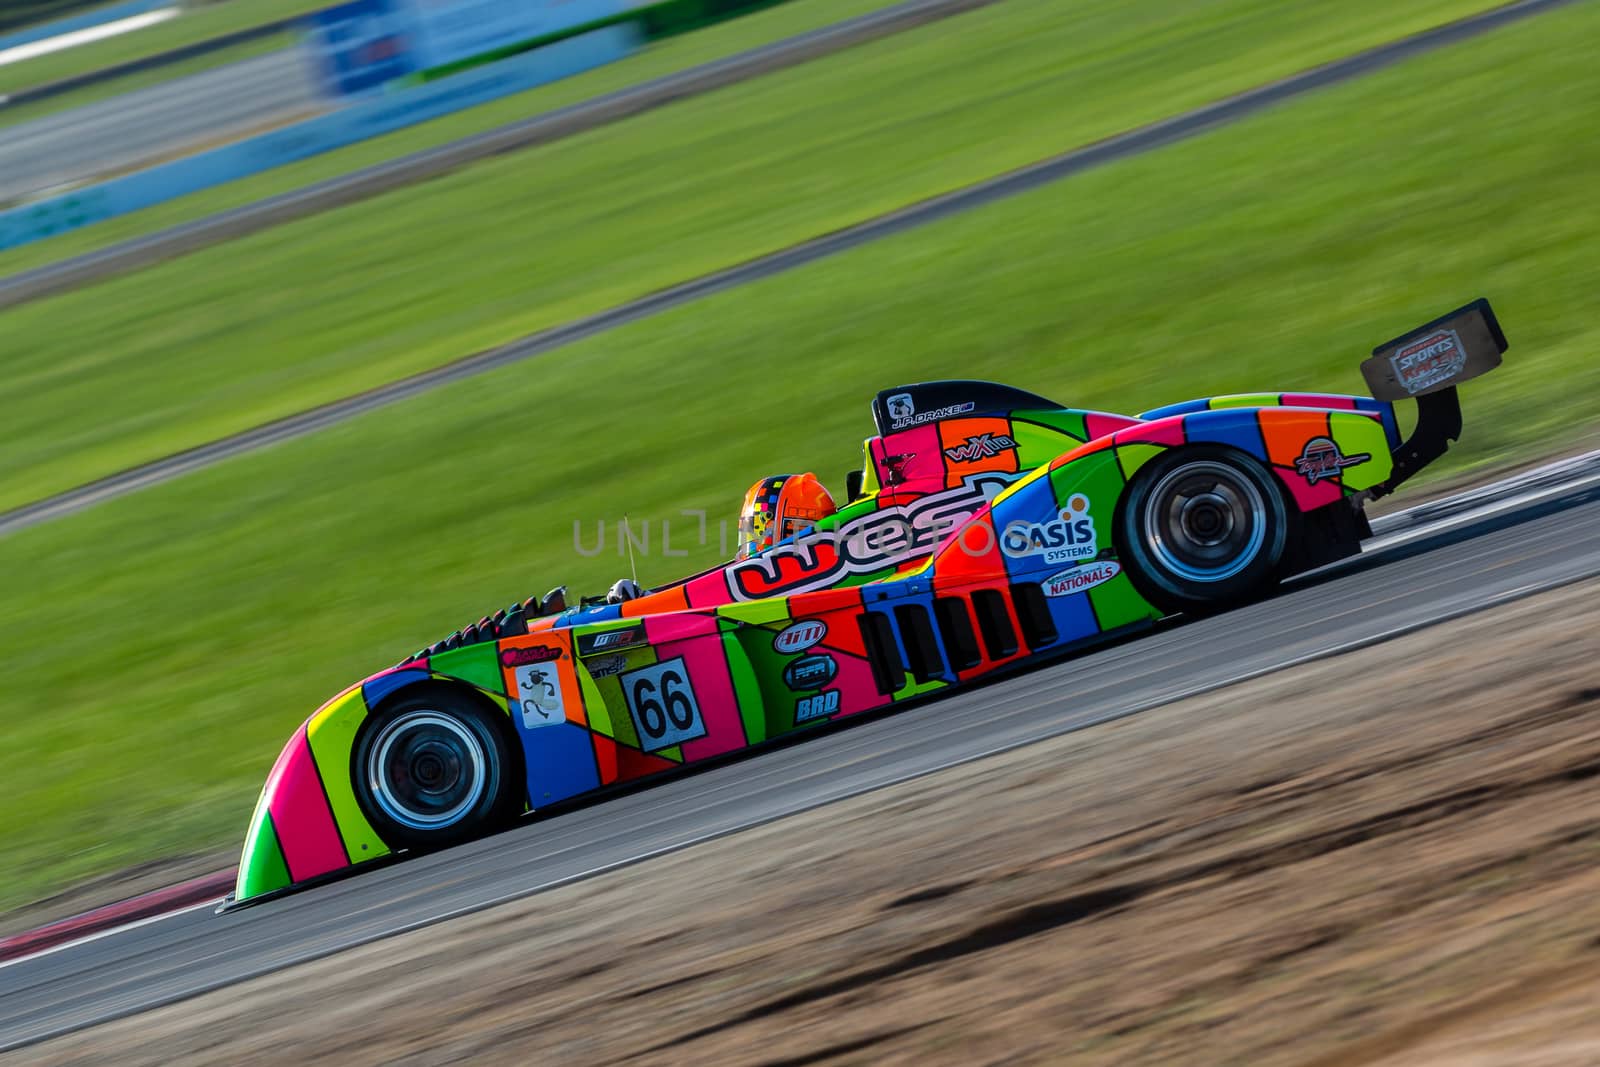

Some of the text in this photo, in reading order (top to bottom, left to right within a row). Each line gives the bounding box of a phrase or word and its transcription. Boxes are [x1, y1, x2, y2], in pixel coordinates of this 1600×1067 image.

[1400, 336, 1454, 371] SPORTS
[1004, 519, 1093, 554] OASIS
[1047, 545, 1094, 561] SYSTEMS
[1050, 566, 1113, 595] NATIONALS
[634, 670, 694, 740] 66
[796, 690, 839, 722] BRD
